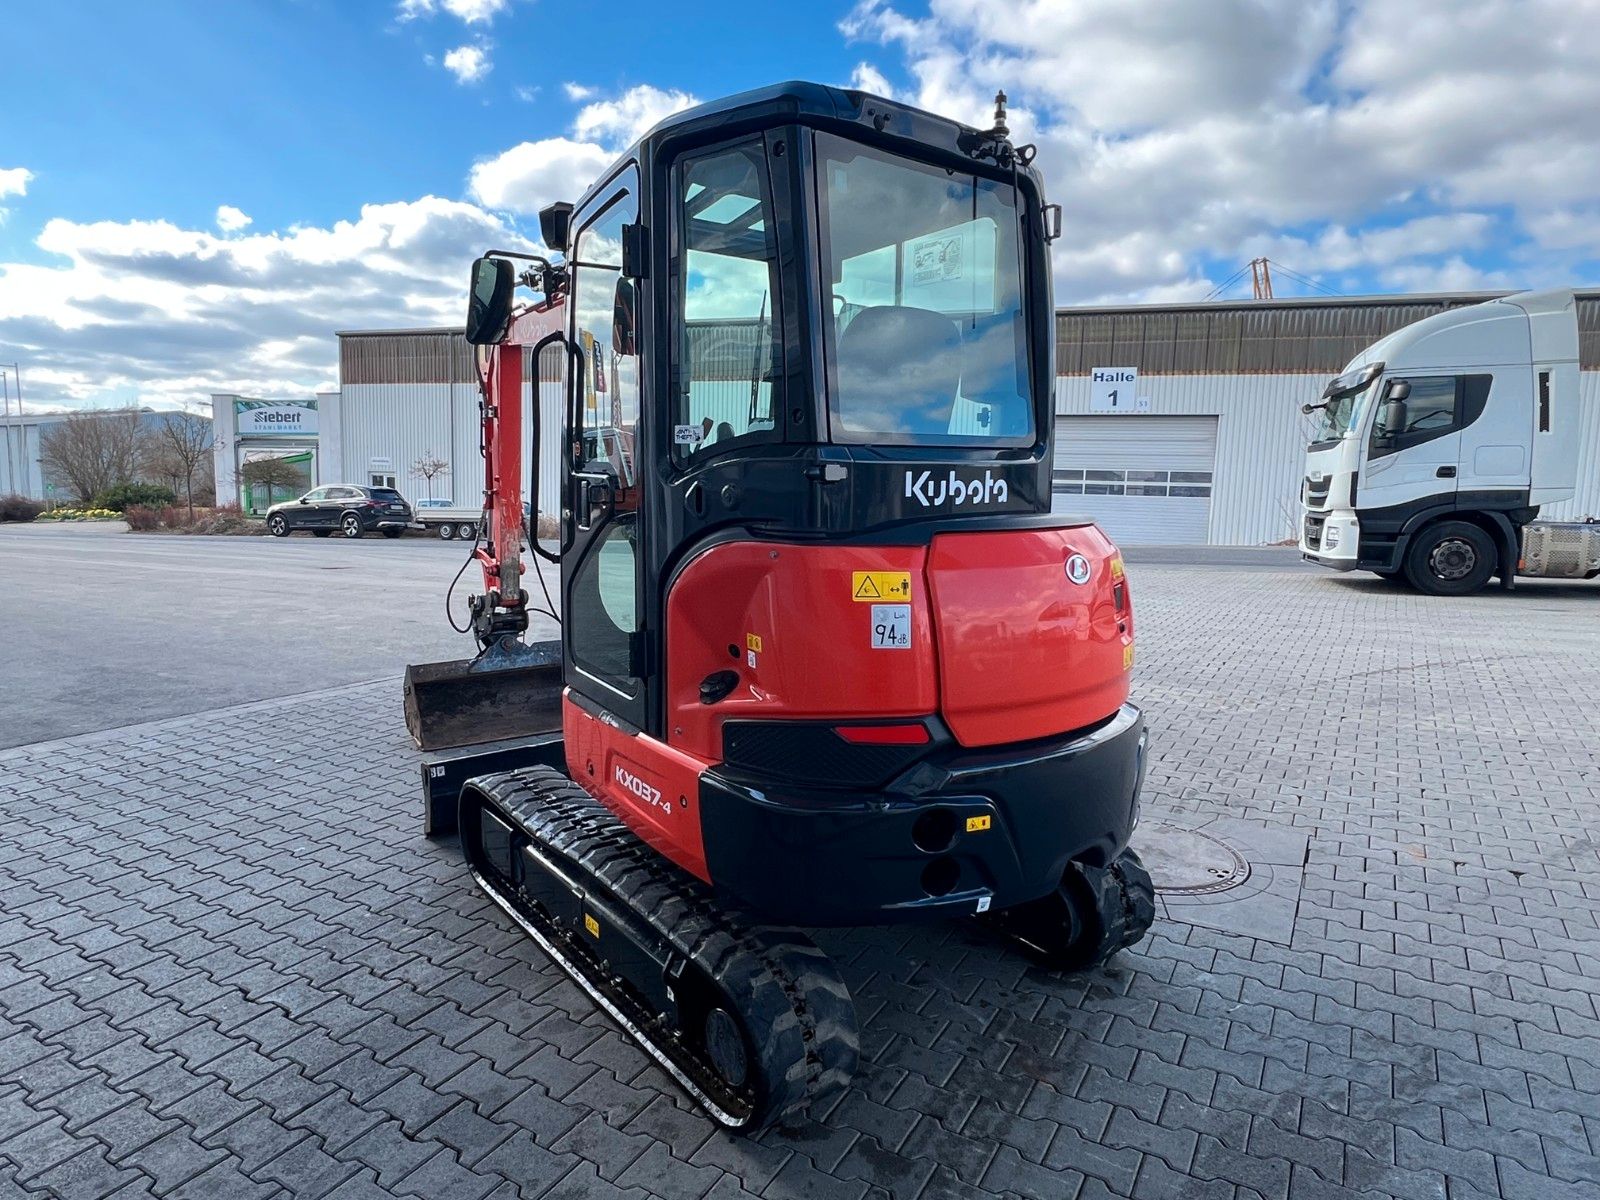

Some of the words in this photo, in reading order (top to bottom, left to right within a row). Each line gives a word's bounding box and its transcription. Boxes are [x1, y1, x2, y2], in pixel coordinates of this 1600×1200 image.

[1093, 372, 1135, 382] Halle
[1107, 390, 1118, 407] 1
[254, 411, 302, 423] Siebert
[905, 469, 1008, 507] Kubota
[615, 765, 671, 815] KX037-4
